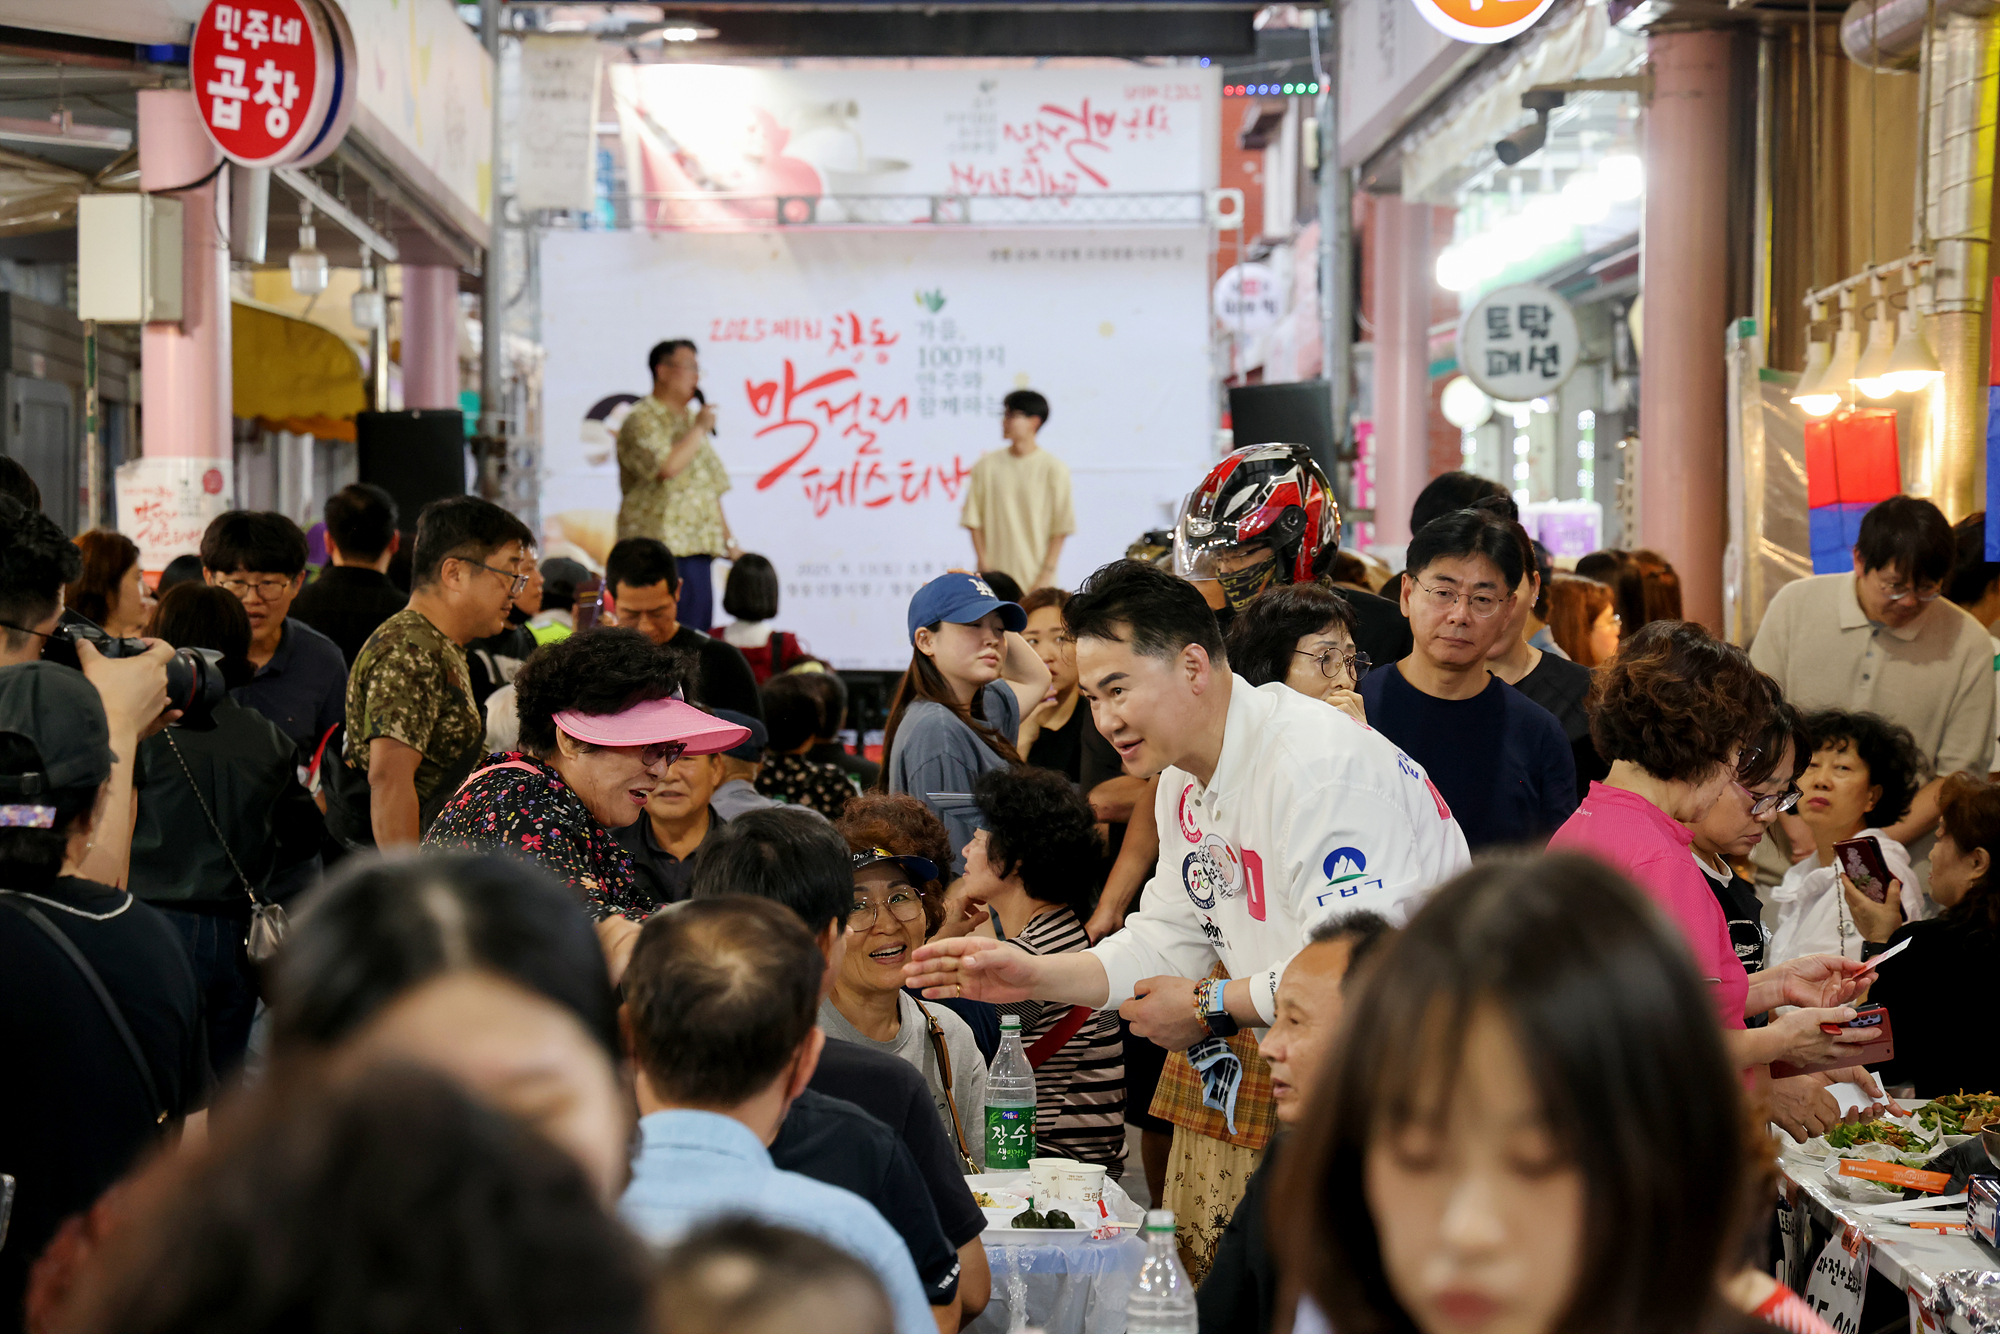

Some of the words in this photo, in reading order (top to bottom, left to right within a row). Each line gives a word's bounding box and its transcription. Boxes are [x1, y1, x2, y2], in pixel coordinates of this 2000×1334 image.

[215, 4, 301, 51] 민주네
[207, 54, 299, 139] 곱창
[709, 318, 767, 342] 2025
[827, 311, 901, 365] 창동
[1486, 344, 1559, 378] 패션
[745, 358, 910, 492] 막걸리
[968, 578, 995, 597] LA
[992, 1124, 1028, 1146] 장수
[951, 1263, 962, 1276] NO
